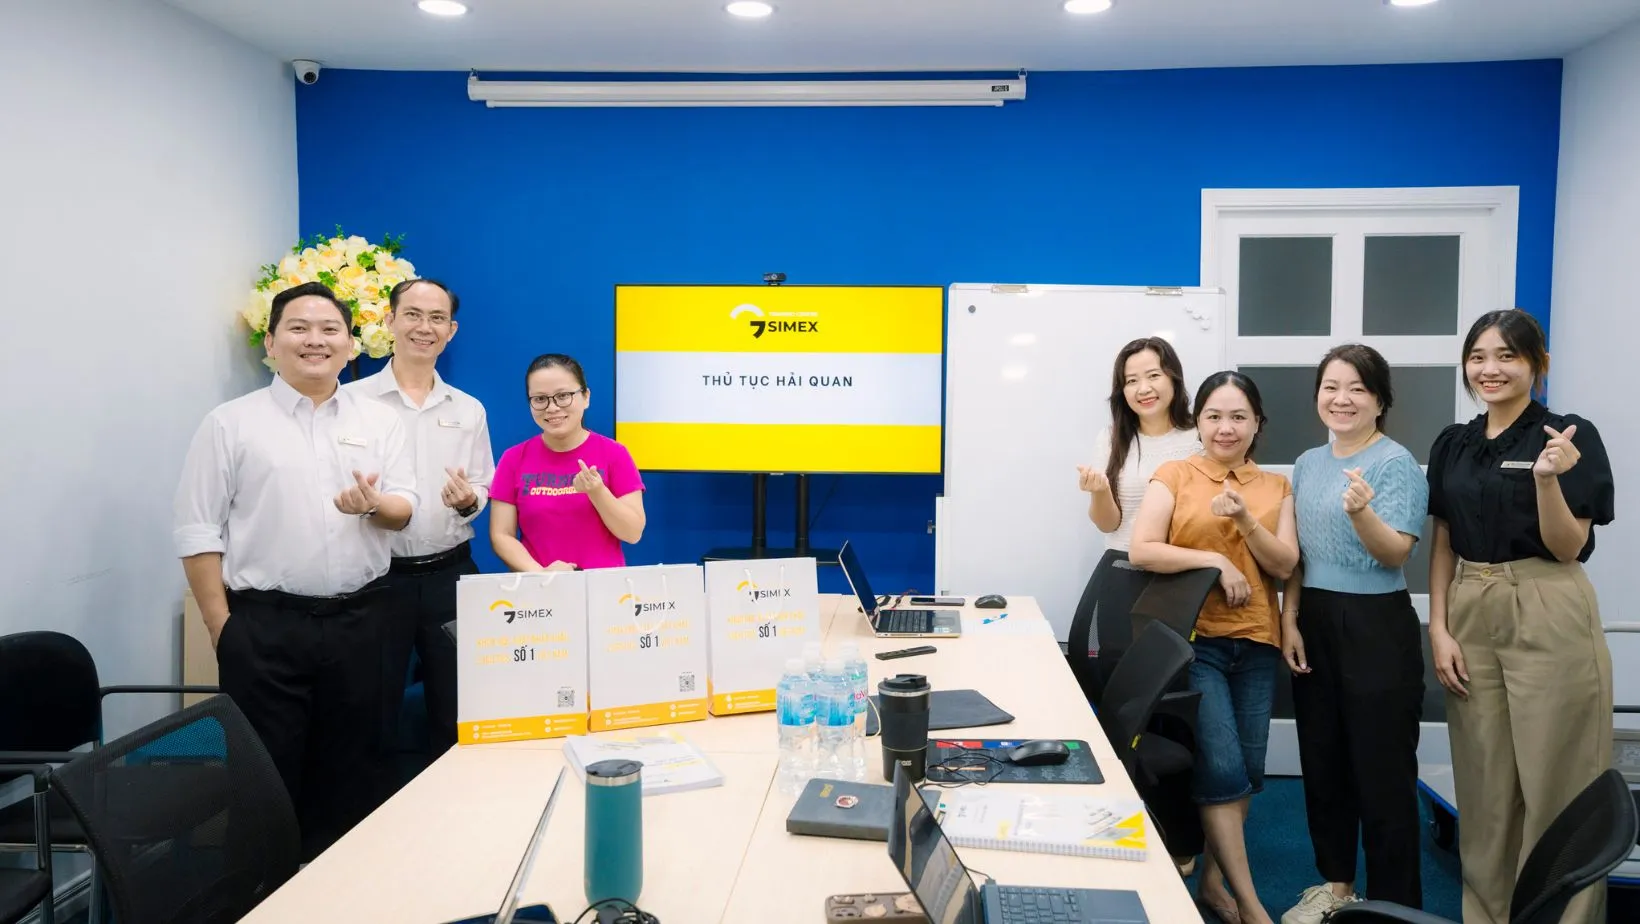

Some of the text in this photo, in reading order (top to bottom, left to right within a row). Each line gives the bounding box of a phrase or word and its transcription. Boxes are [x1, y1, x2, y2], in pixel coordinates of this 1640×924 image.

[768, 321, 818, 332] SIMEX
[702, 371, 853, 390] THỦ TỤC HẢI QUAN
[517, 608, 553, 619] SIMEX
[758, 621, 770, 638] SỐ
[772, 625, 777, 637] 1
[654, 635, 659, 647] 1
[513, 645, 528, 662] SỐ
[530, 648, 535, 661] 1
